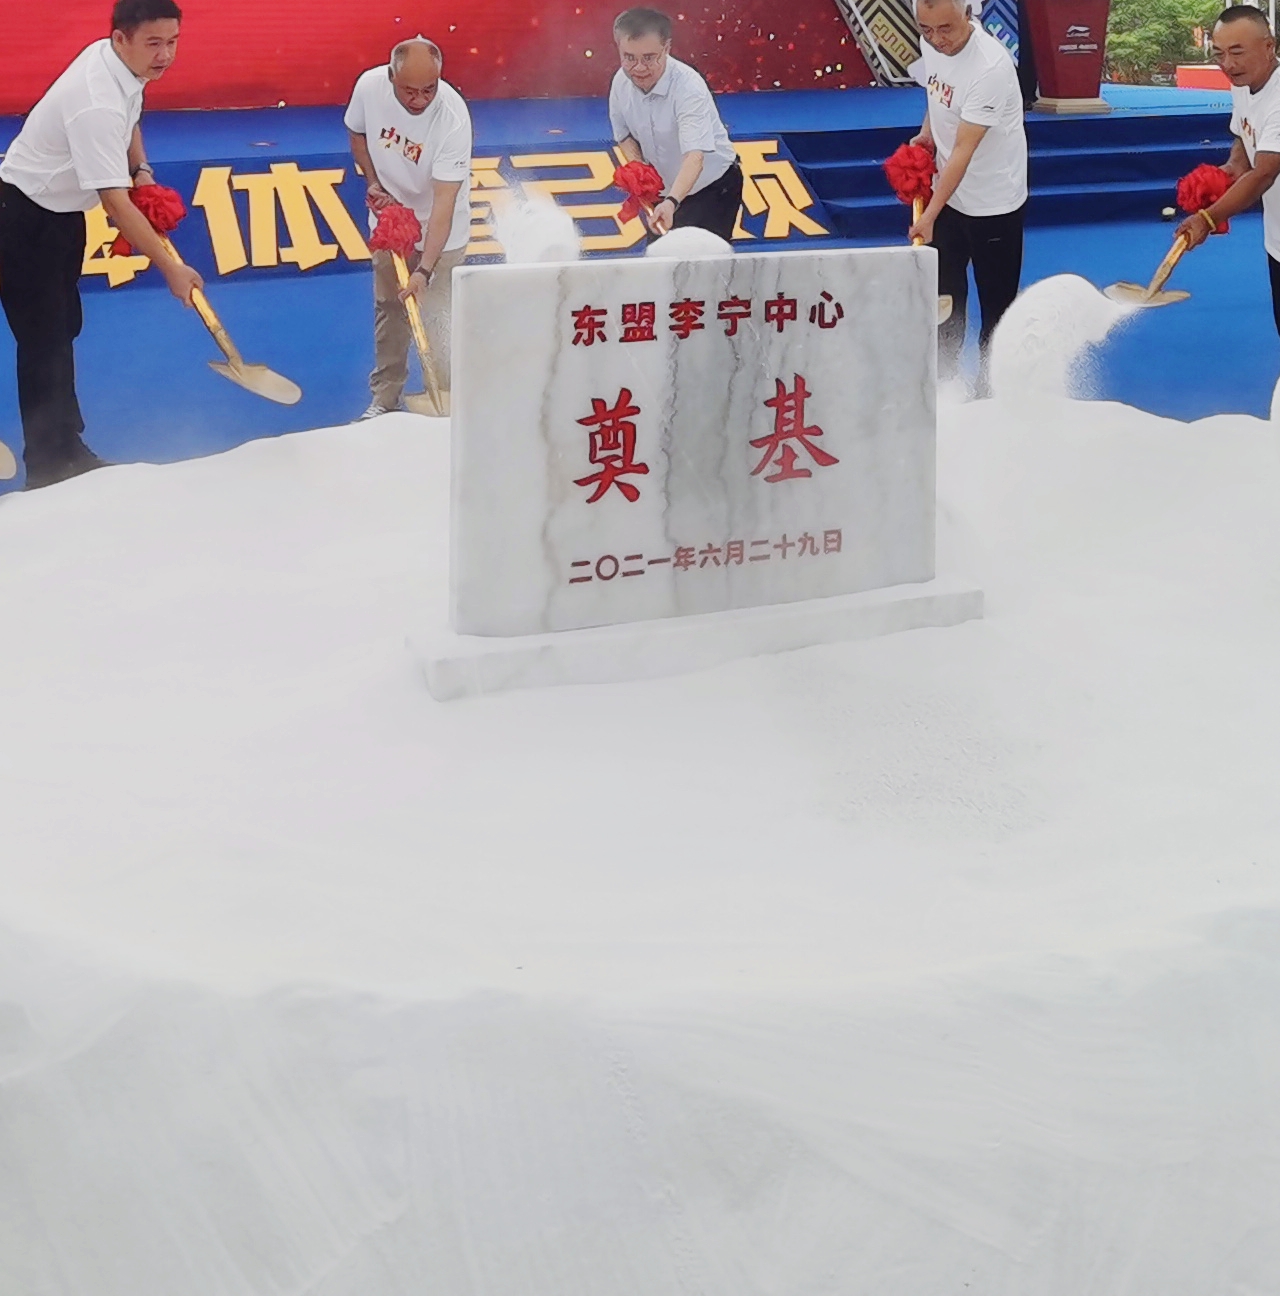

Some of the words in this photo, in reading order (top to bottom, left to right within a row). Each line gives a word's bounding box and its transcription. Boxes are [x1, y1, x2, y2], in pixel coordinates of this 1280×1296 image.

[571, 290, 845, 346] 东盟李宁中心
[573, 373, 840, 505] 奠基
